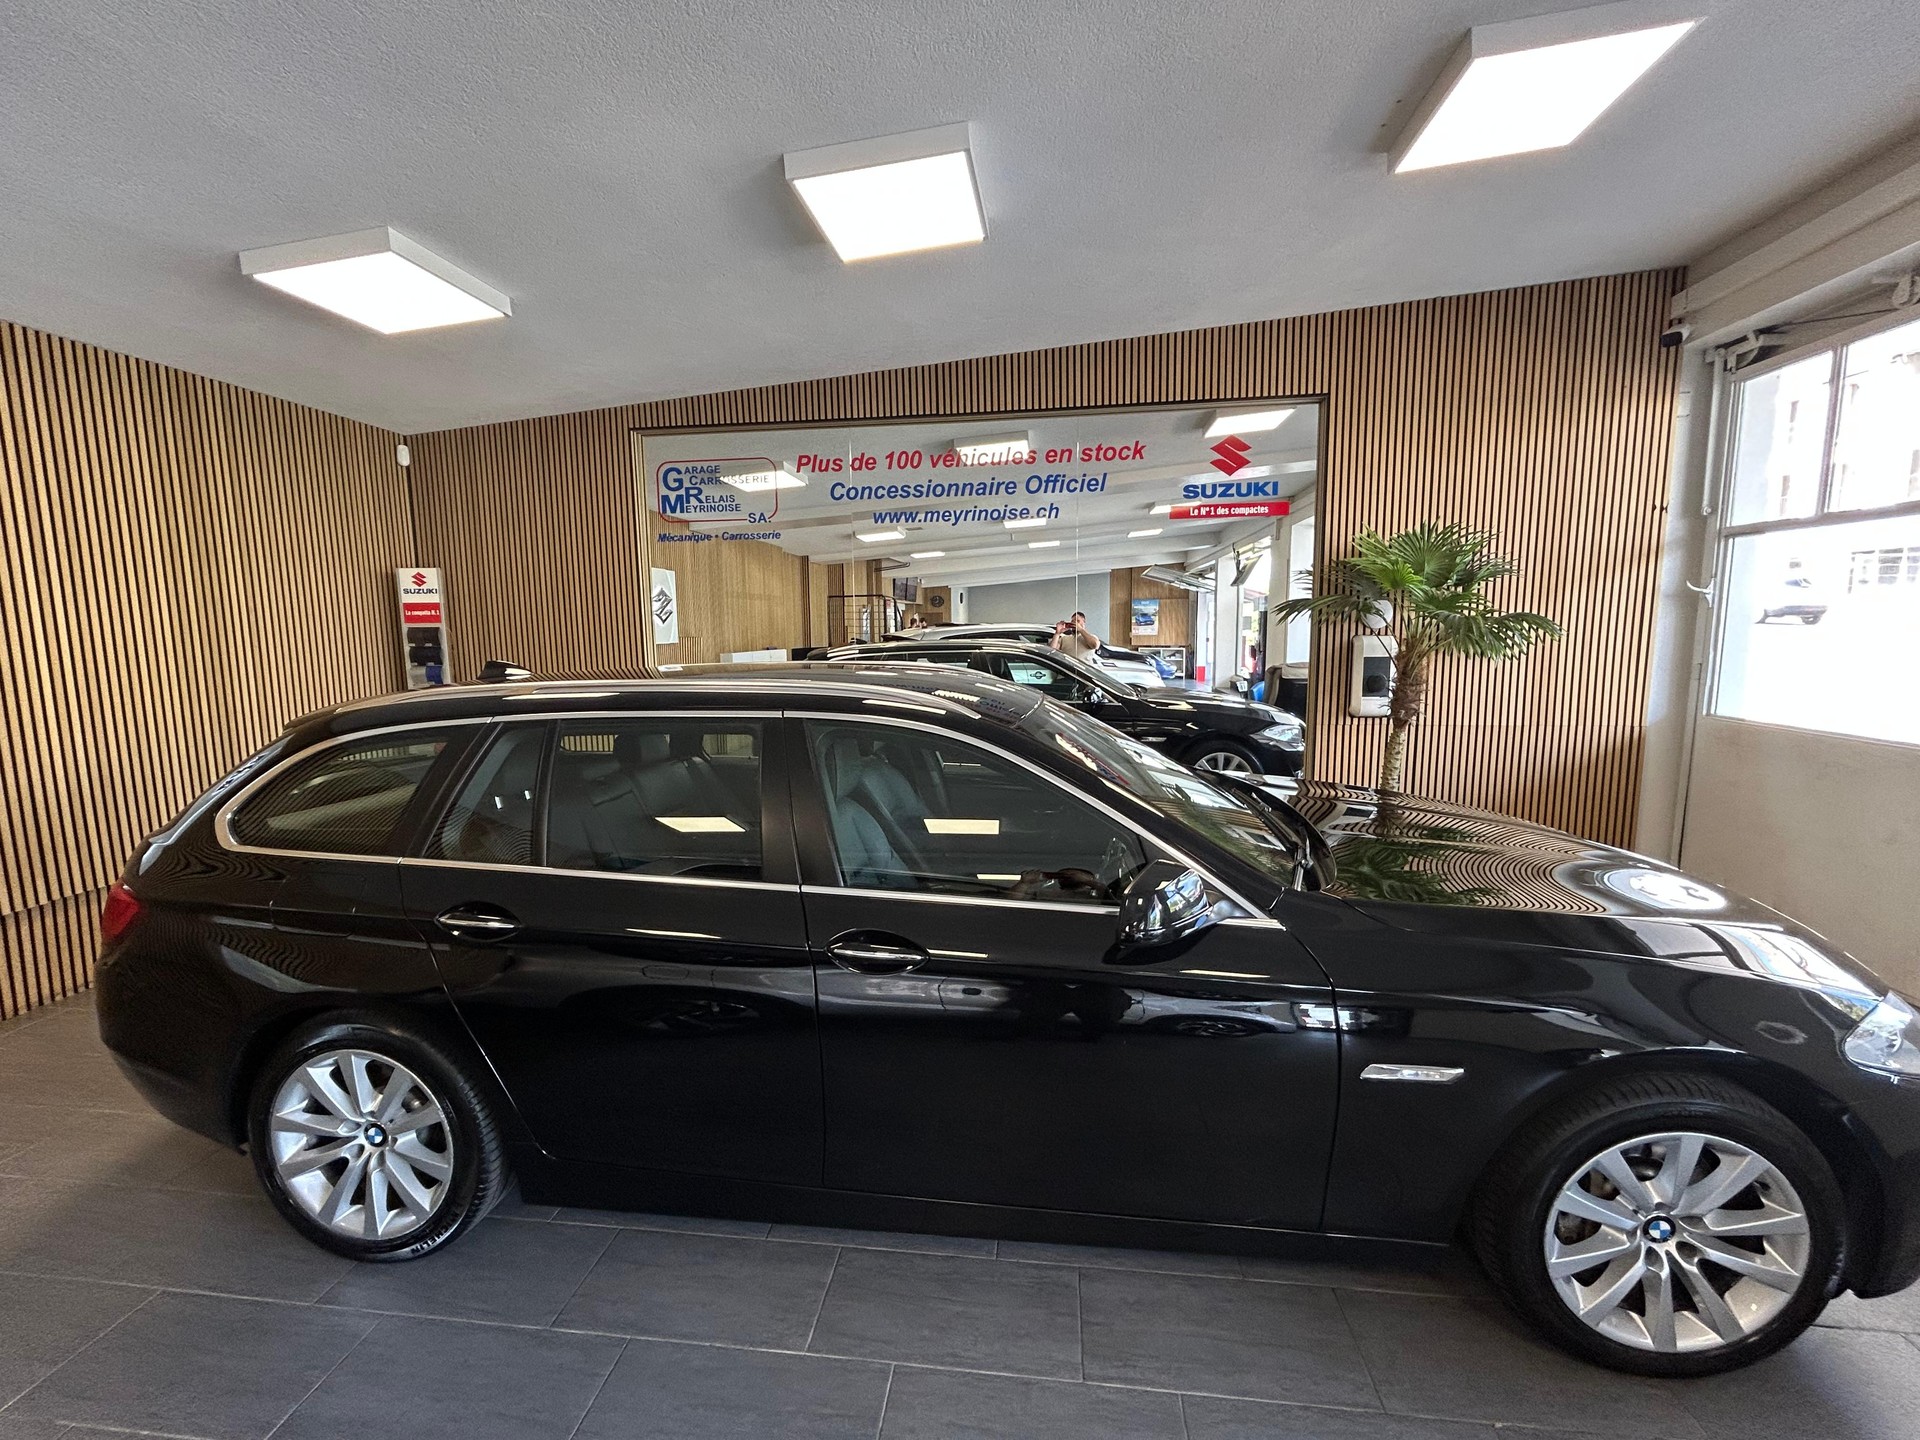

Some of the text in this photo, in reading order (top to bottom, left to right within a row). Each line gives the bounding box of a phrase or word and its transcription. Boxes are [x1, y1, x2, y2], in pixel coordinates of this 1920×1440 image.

[796, 441, 1147, 473] Plus de 100 véhicules en stock
[830, 473, 1108, 501] Concessionnaire Officiel
[1182, 481, 1279, 499] SUZUKI
[873, 503, 1060, 526] www.meyrinoise.ch
[1190, 507, 1199, 516] Le
[1217, 505, 1228, 515] des
[1231, 505, 1269, 516] compactes
[658, 531, 782, 543] Mécanique Carrosserie
